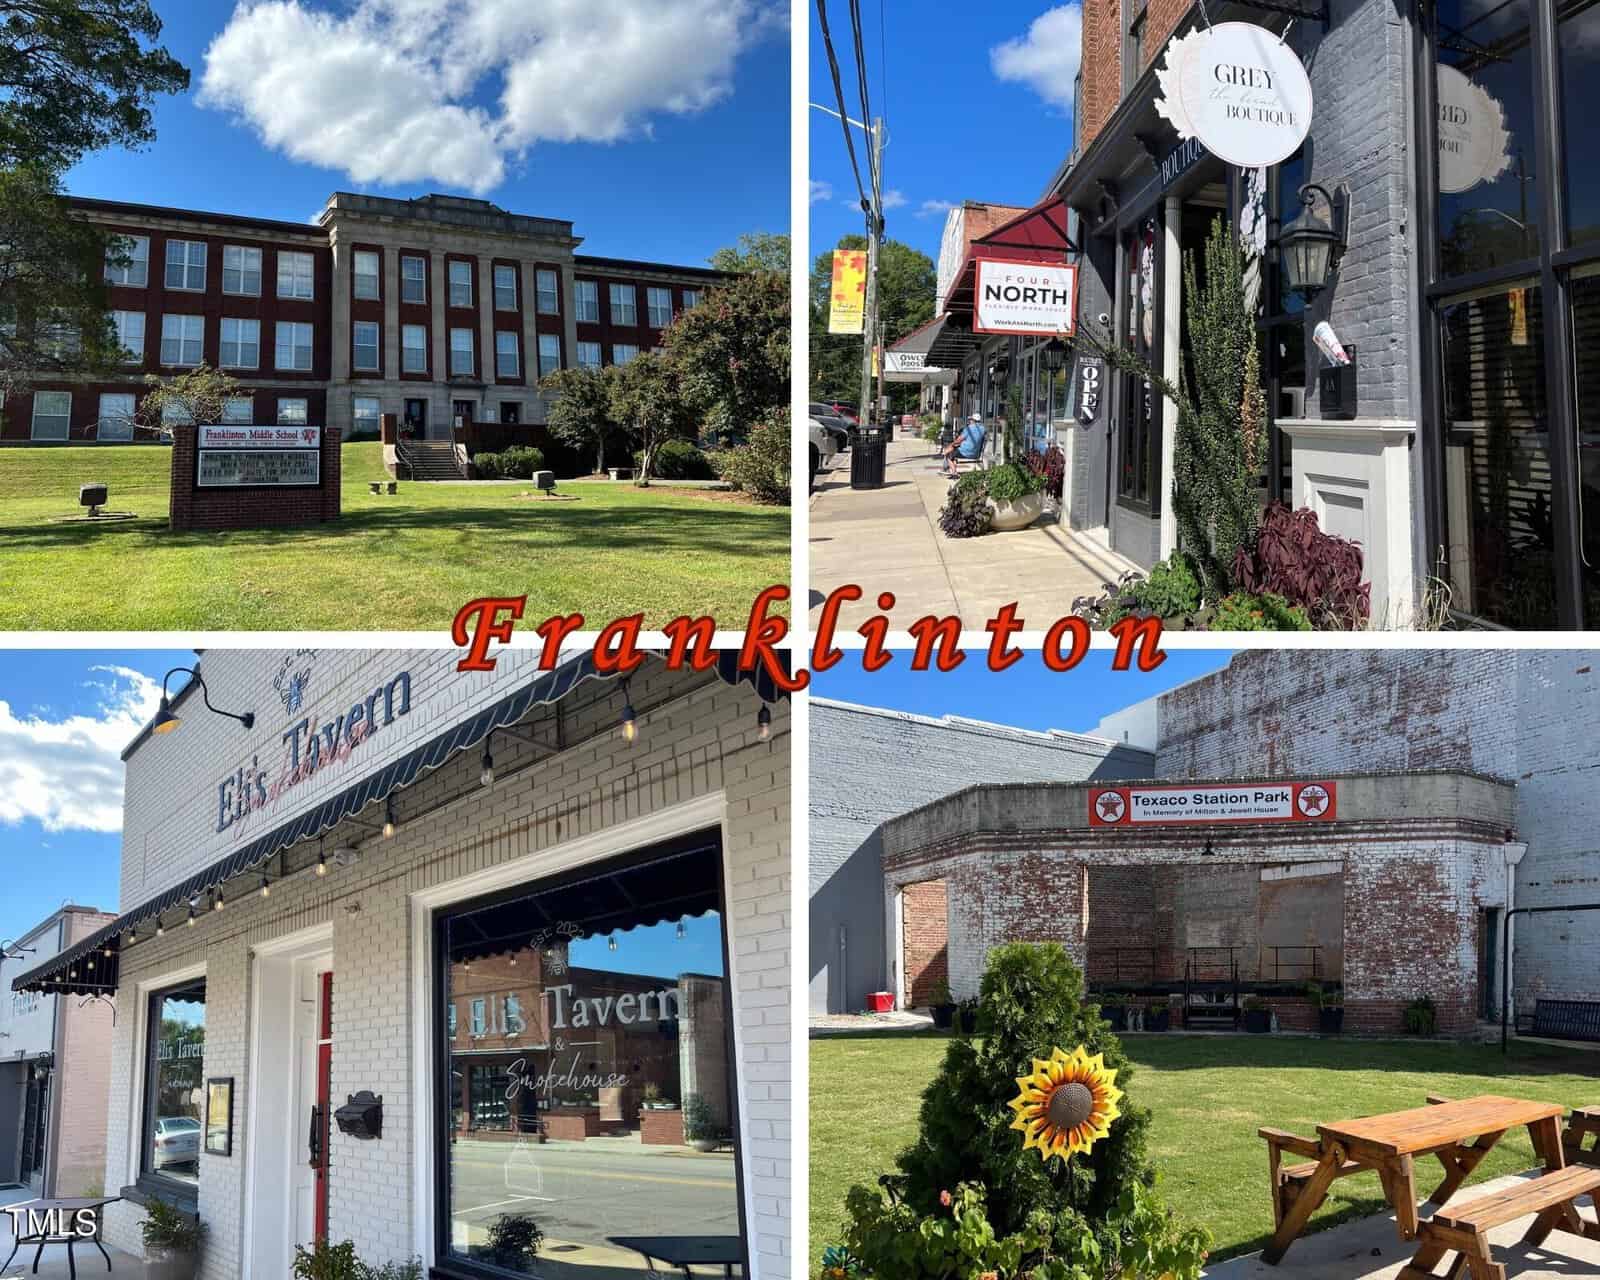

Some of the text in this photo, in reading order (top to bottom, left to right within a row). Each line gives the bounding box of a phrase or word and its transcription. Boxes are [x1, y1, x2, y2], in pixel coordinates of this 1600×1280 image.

[1214, 63, 1277, 90] GREY
[1226, 103, 1297, 127] BOUTIQUE
[1005, 275, 1050, 285] FOUR
[985, 285, 1067, 305] NORTH
[1080, 366, 1099, 420] OPEN
[206, 429, 298, 440] Franklinton Middle School
[282, 670, 412, 772] Tavern
[1132, 791, 1289, 807] Texaco Station Park
[1143, 809, 1151, 817] In
[1153, 809, 1183, 817] Memory
[1185, 808, 1193, 816] of
[545, 984, 689, 1029] Tavern
[554, 1036, 566, 1051] &
[505, 1051, 630, 1100] Smokehouse
